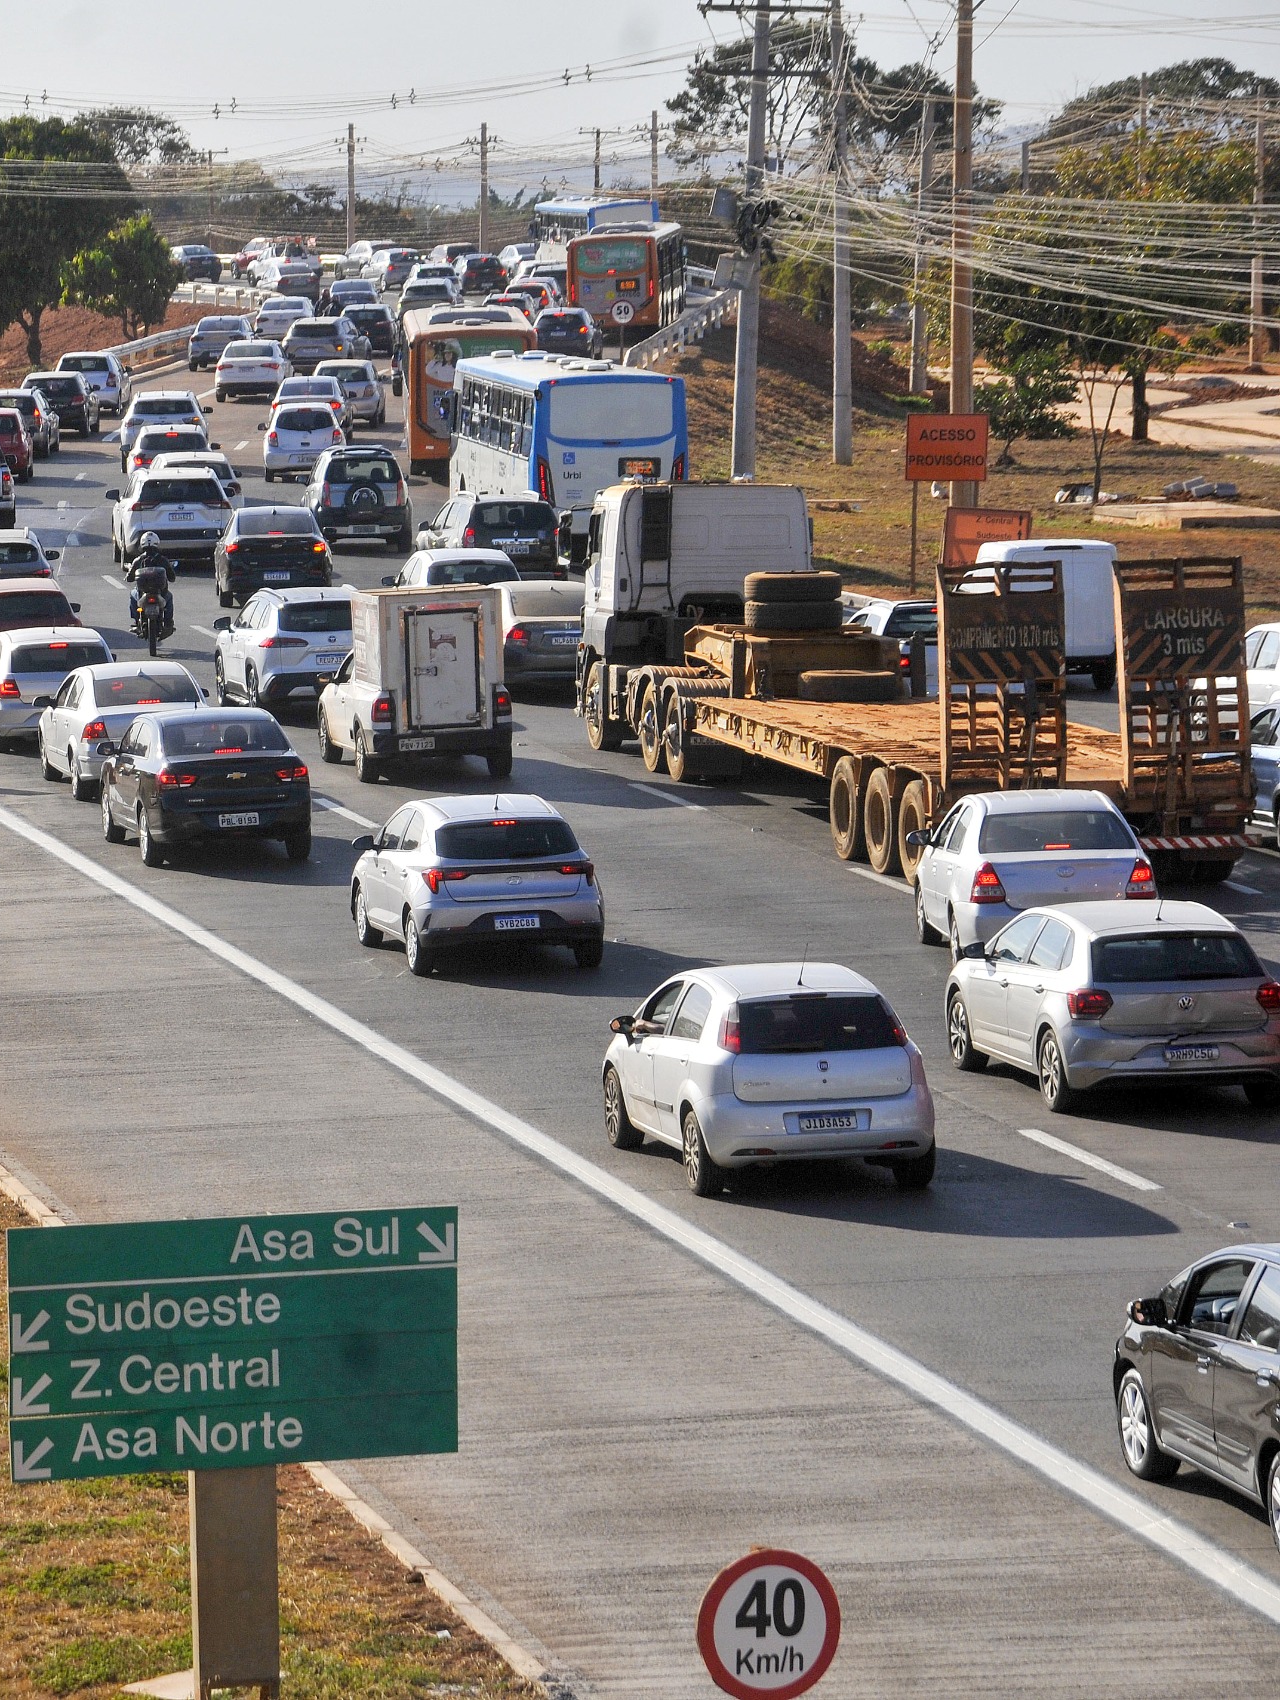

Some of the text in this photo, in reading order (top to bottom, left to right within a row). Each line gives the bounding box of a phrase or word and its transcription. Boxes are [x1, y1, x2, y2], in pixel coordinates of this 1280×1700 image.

[616, 305, 630, 316] 50
[919, 429, 976, 442] ACESSO
[908, 452, 985, 466] PROVISÓRIO
[563, 471, 582, 480] Urbi
[985, 515, 1014, 525] Central
[976, 531, 1012, 540] Sudoeste
[1144, 606, 1226, 630] LARGURA
[1163, 633, 1206, 656] 3 mts
[230, 1216, 400, 1264] Asa Sul
[64, 1286, 282, 1335] Sudoeste
[70, 1348, 281, 1400] Z.Central
[72, 1411, 303, 1463] Asa Norte
[735, 1577, 806, 1638] 40
[735, 1645, 804, 1675] Km/h
